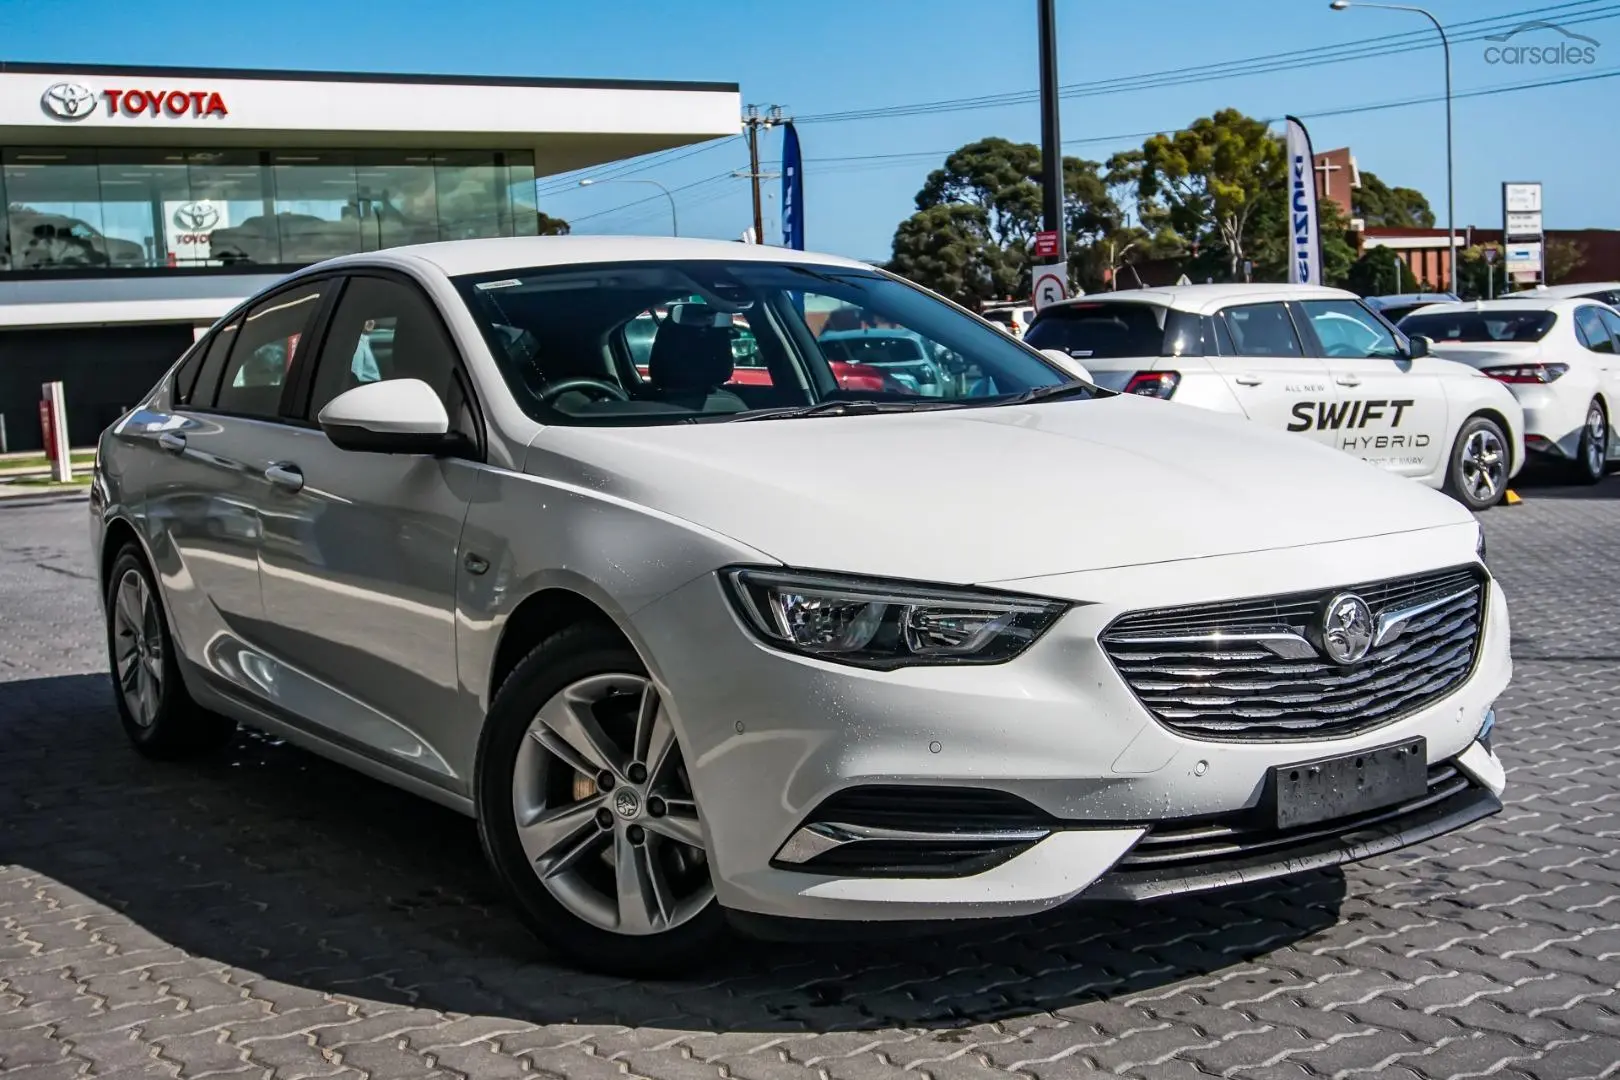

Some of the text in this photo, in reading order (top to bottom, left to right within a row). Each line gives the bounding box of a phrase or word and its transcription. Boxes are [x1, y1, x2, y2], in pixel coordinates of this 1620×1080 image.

[104, 90, 228, 115] TOYOTA
[1043, 287, 1055, 303] 5
[1287, 400, 1415, 432] SWIFT
[1342, 434, 1431, 450] HYBRID
